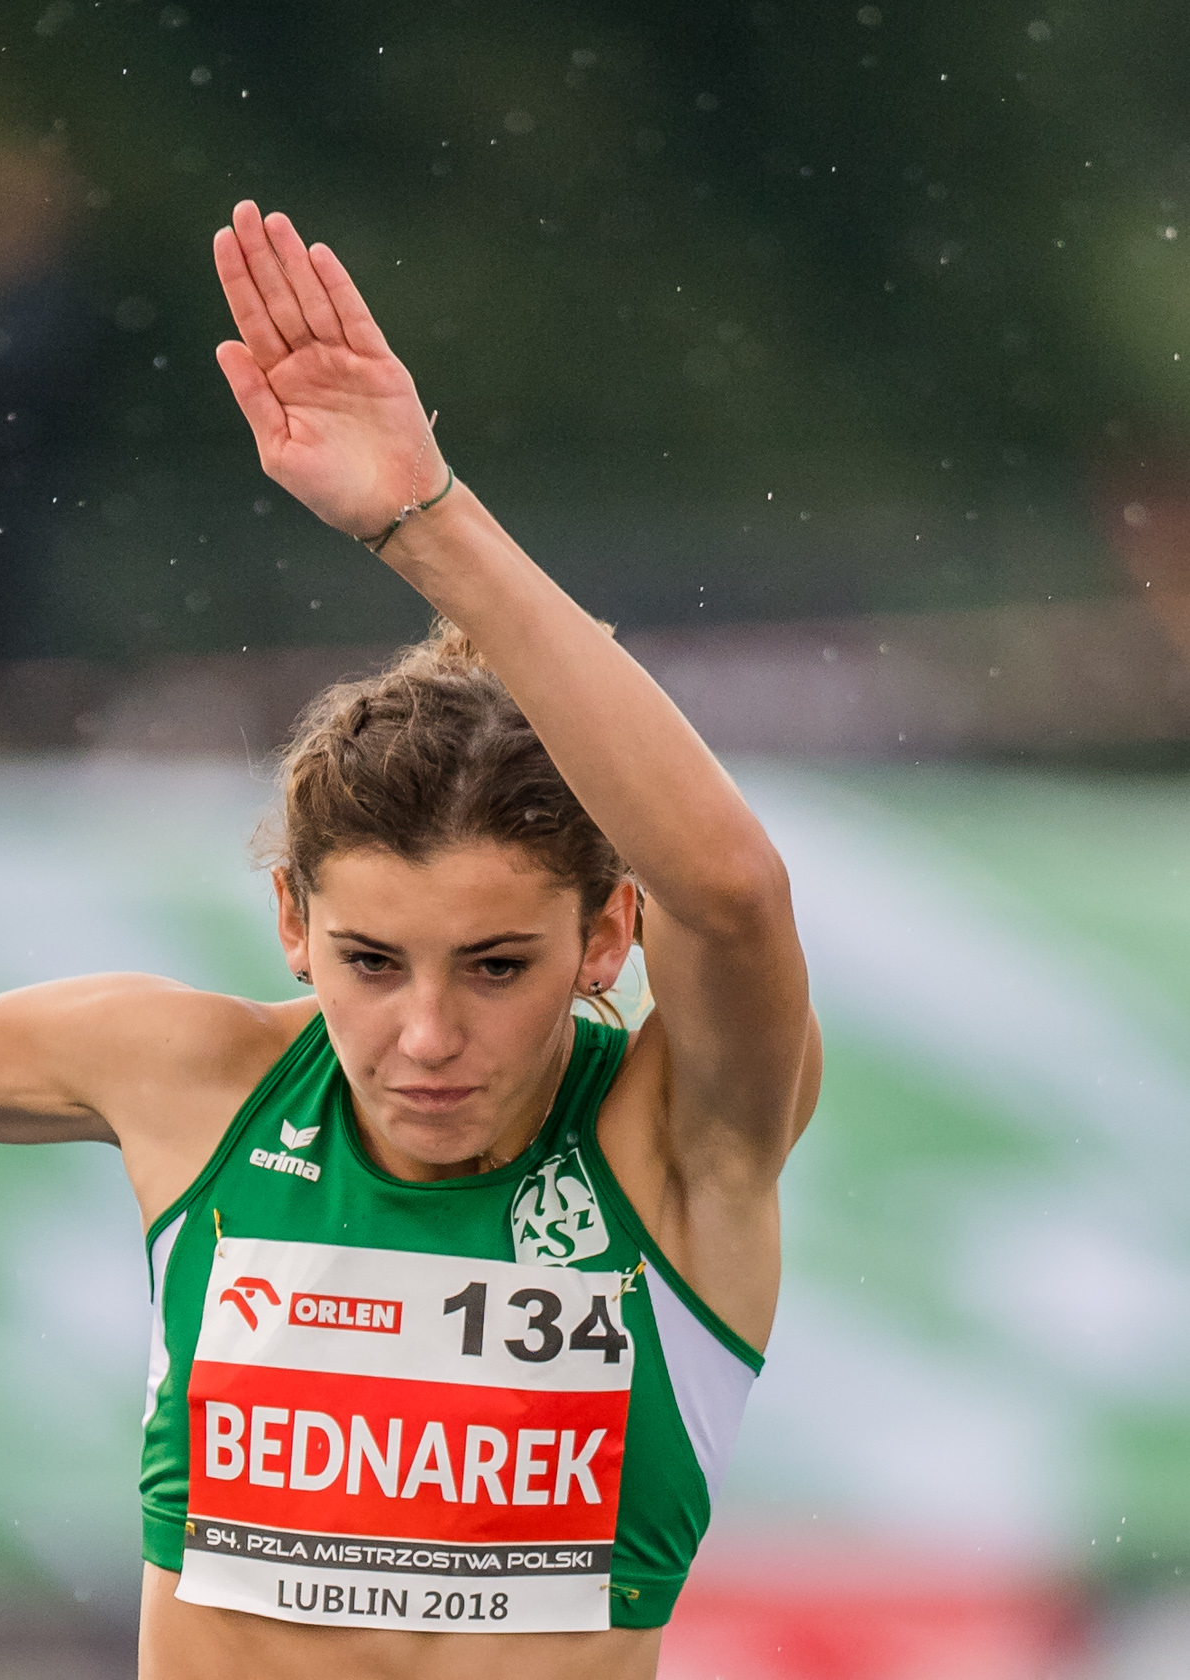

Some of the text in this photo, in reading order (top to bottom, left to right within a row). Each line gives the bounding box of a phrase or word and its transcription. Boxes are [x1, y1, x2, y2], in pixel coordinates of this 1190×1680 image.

[249, 1148, 321, 1182] erima
[295, 1297, 396, 1329] ORLEN
[443, 1282, 628, 1364] 134
[205, 1401, 607, 1506] BEDNAREK
[206, 1528, 593, 1570] 94. PZLA MISTRZOSTWA POLSKI
[277, 1580, 509, 1620] LUBLIN 2018
